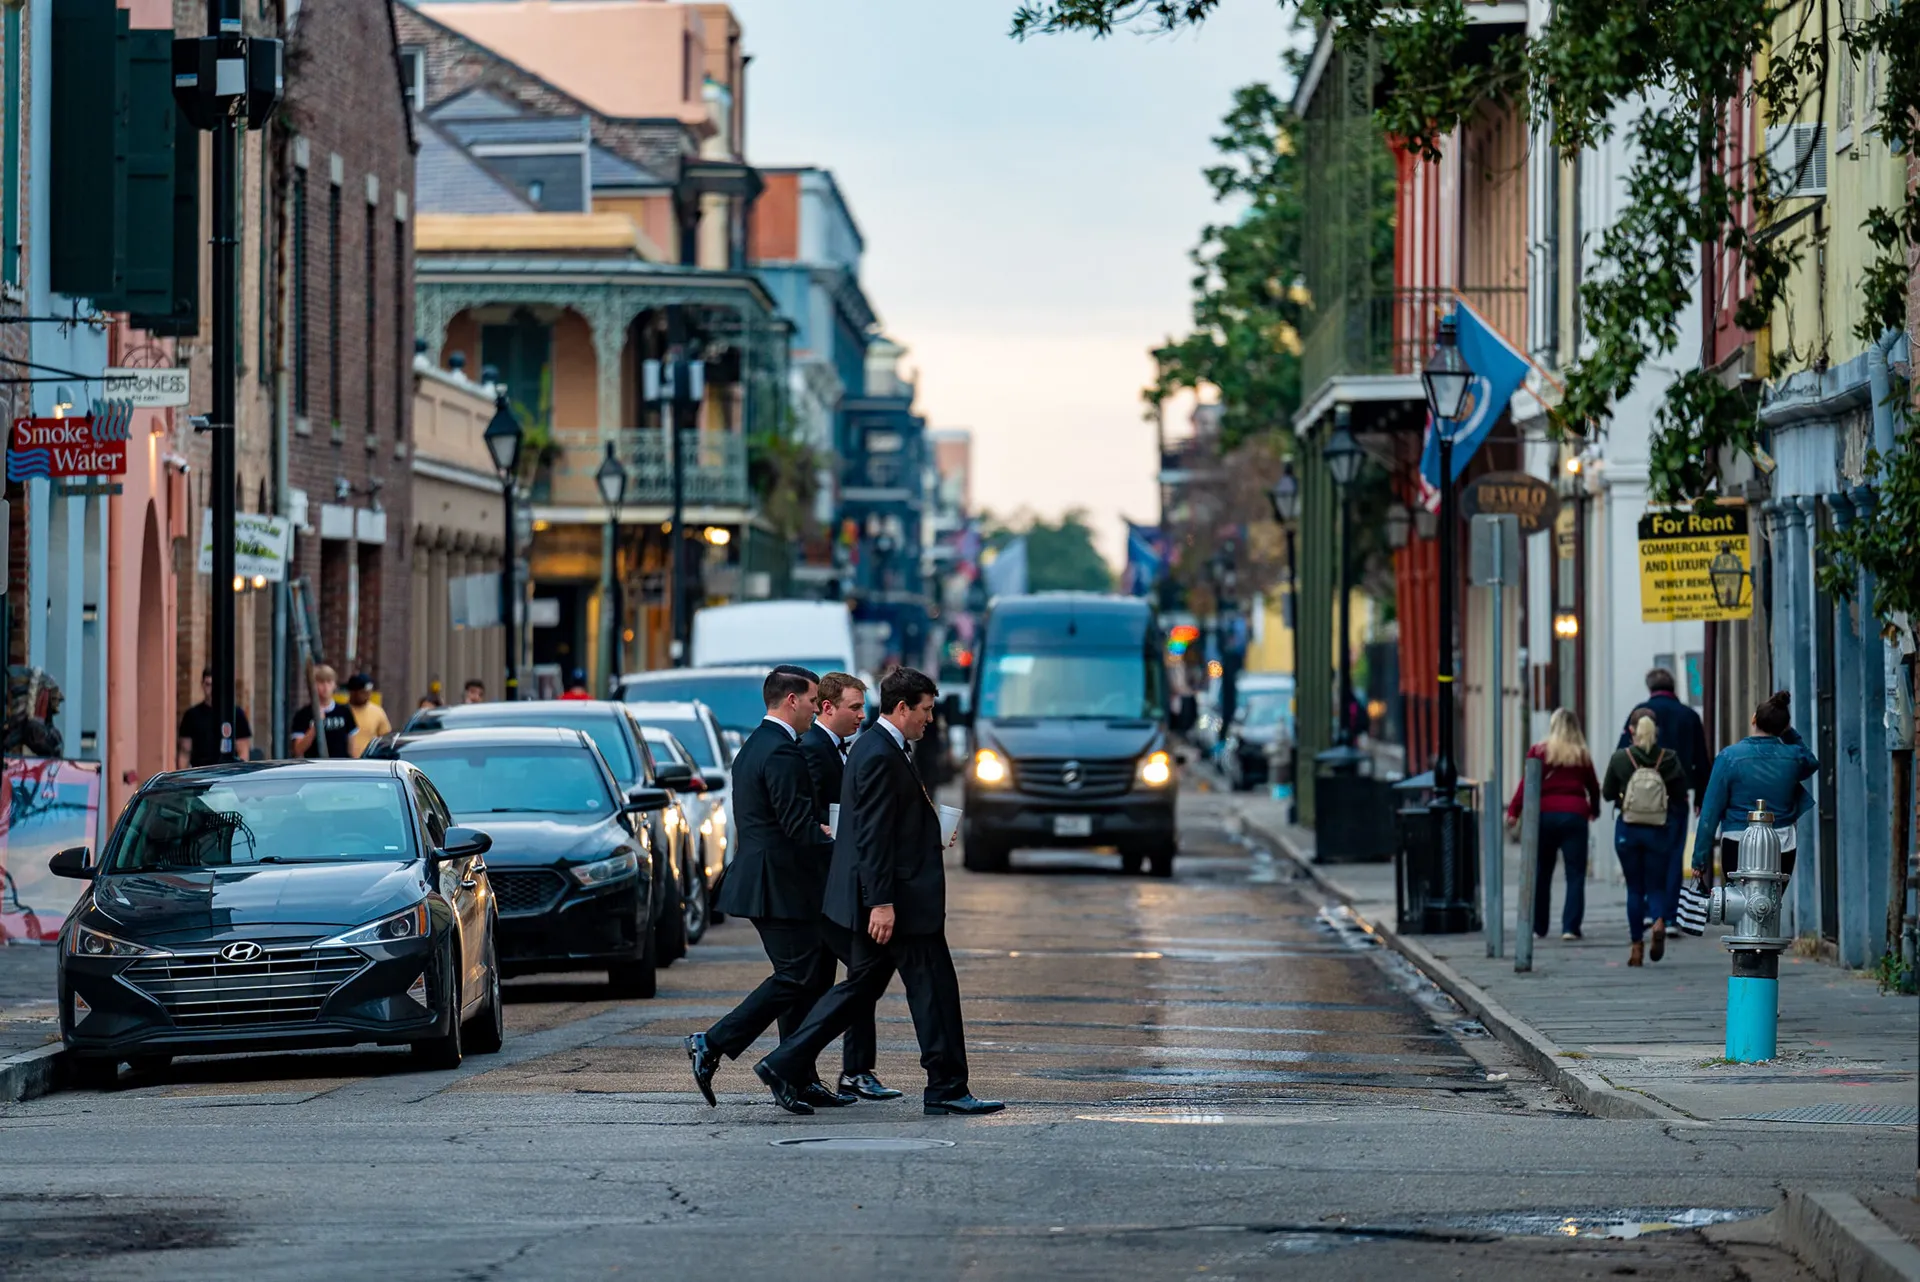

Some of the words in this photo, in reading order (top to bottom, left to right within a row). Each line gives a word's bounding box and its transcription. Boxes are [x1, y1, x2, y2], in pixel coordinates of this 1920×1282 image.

[106, 375, 186, 393] BARONESS
[17, 419, 89, 445] Smoke
[52, 448, 123, 472] Water
[1652, 515, 1684, 534] For
[1688, 514, 1734, 532] Rent
[1641, 541, 1712, 556] COMMERCIAL
[1645, 560, 1669, 573] AND
[1670, 558, 1713, 572] LUXURY
[1654, 578, 1684, 589] NEWLY
[1660, 593, 1708, 603] AVAILABLE
